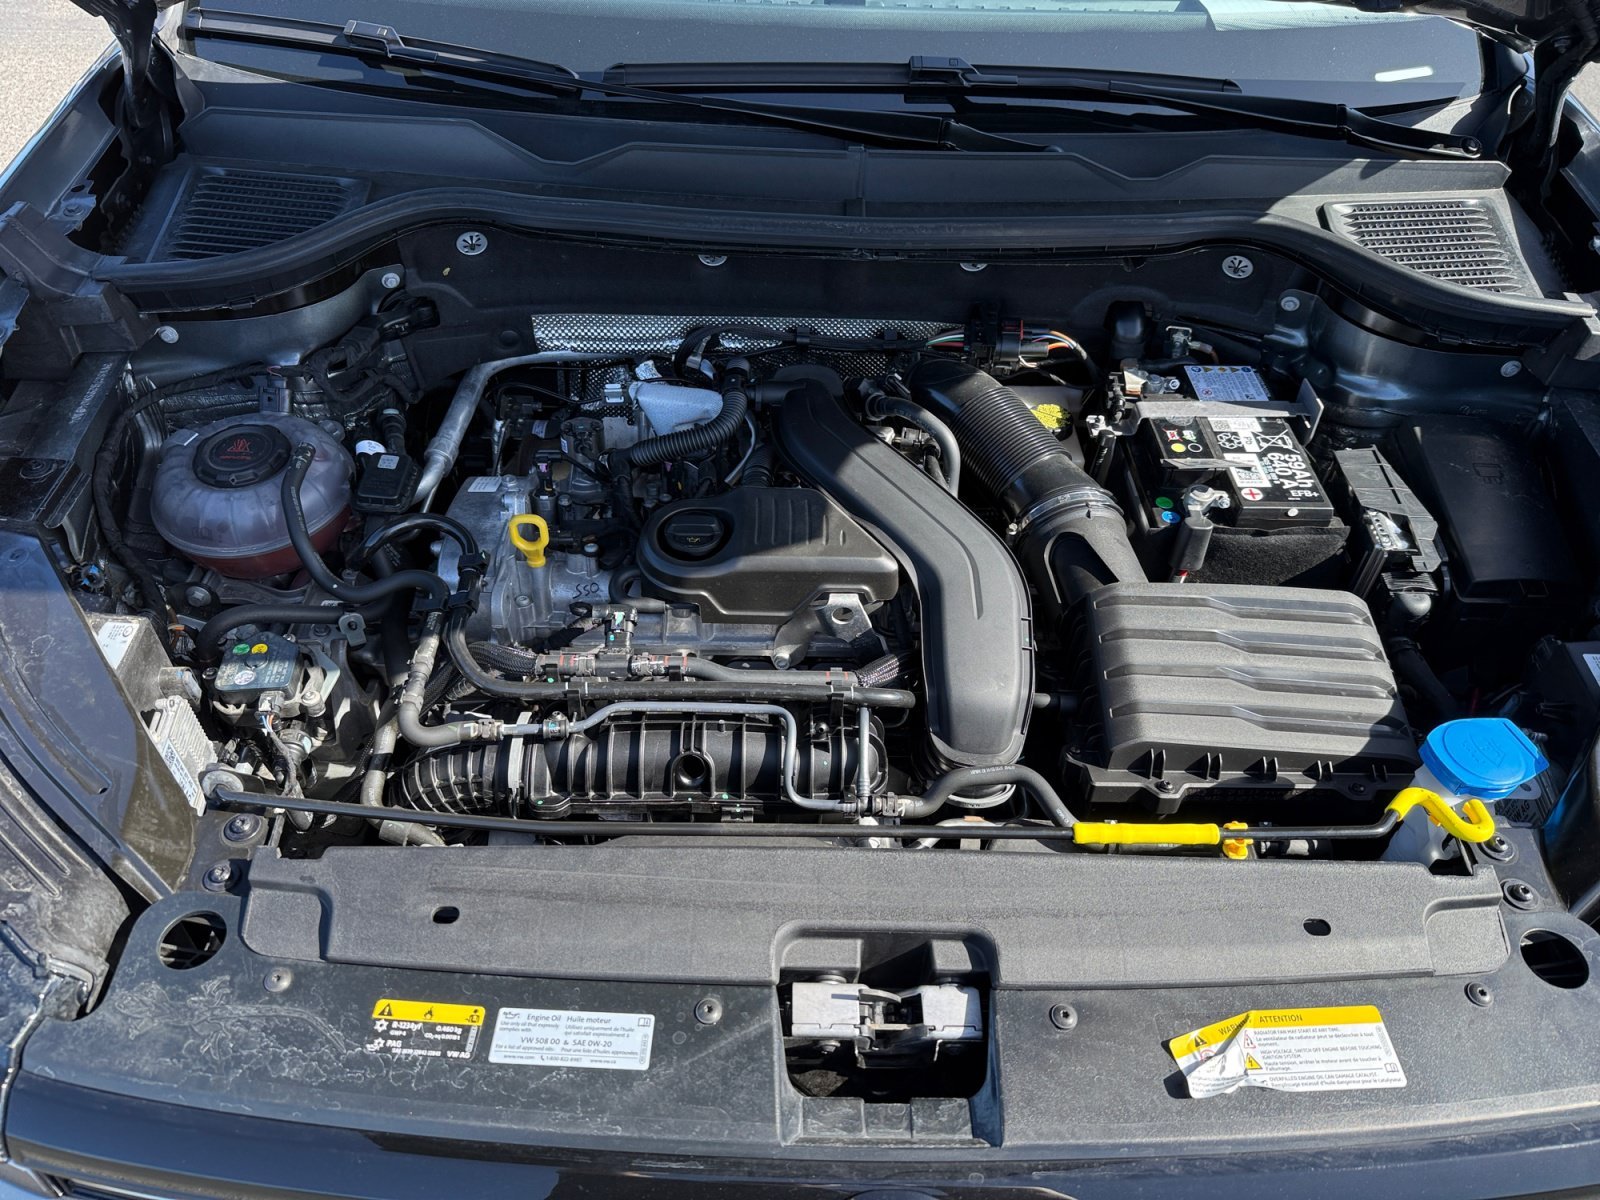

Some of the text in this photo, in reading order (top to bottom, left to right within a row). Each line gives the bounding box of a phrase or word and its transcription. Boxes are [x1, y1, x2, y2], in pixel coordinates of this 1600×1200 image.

[1267, 452, 1293, 476] 640
[1284, 454, 1314, 487] 59Ah
[527, 1014, 550, 1022] Engine
[1259, 1014, 1303, 1023] ATTENTION
[386, 1040, 402, 1048] PAG
